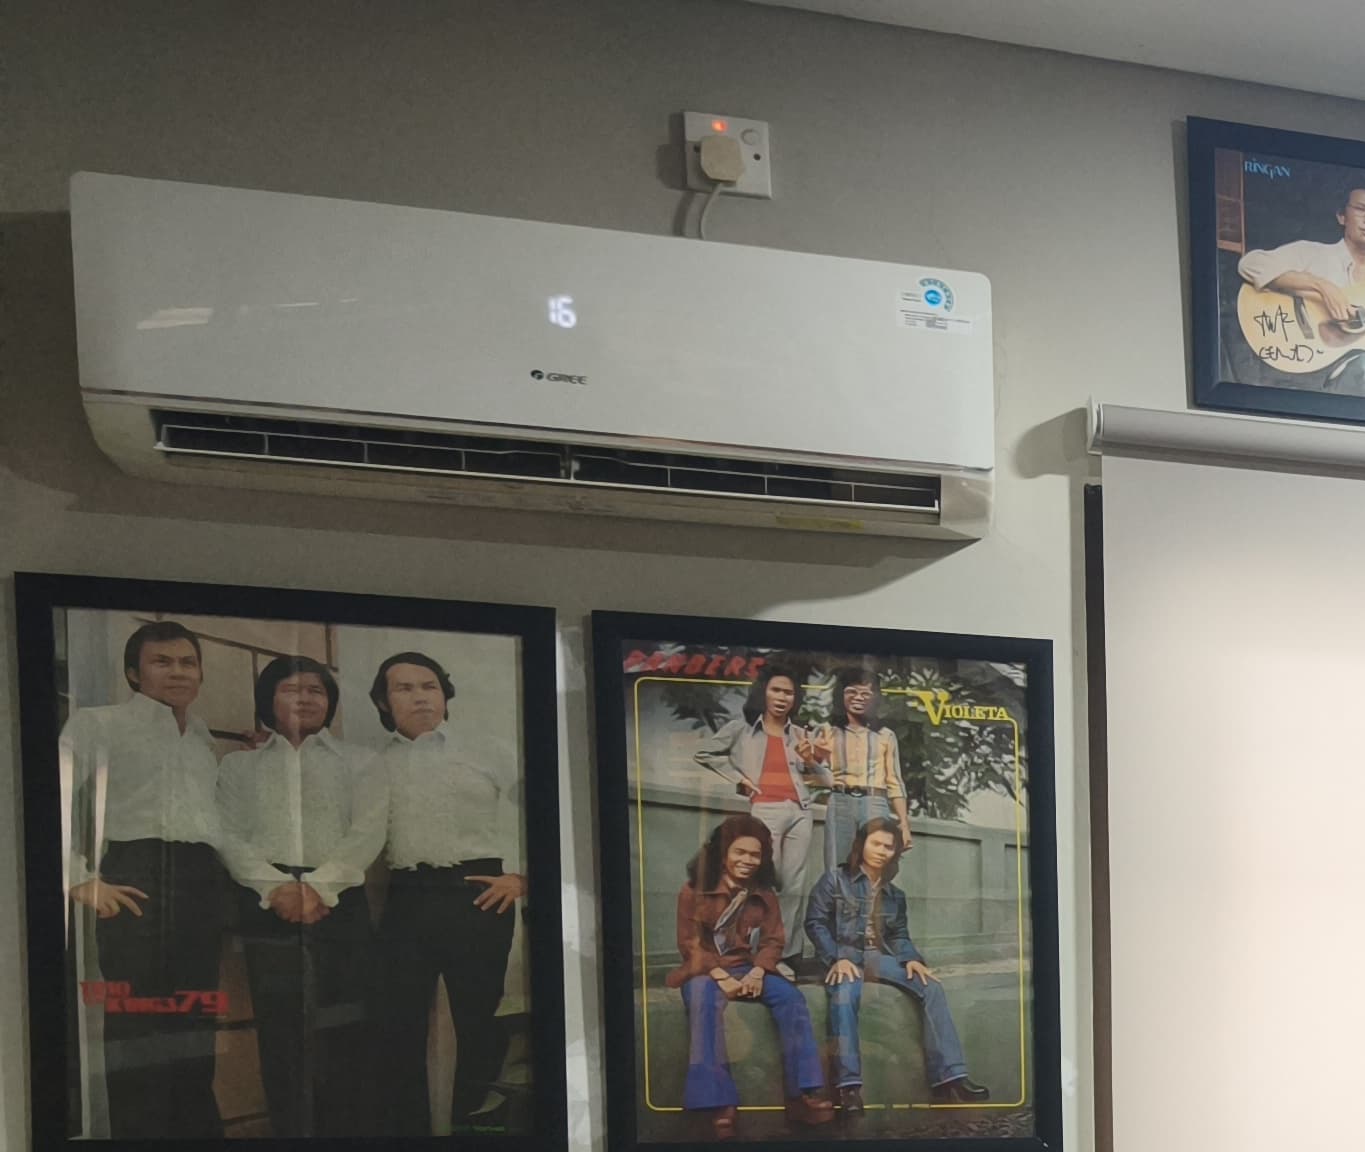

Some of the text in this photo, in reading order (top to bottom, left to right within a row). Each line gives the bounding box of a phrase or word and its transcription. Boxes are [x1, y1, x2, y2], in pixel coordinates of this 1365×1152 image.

[547, 295, 577, 328] 16
[546, 373, 590, 385] GREE
[920, 689, 1010, 725] VIOLETA
